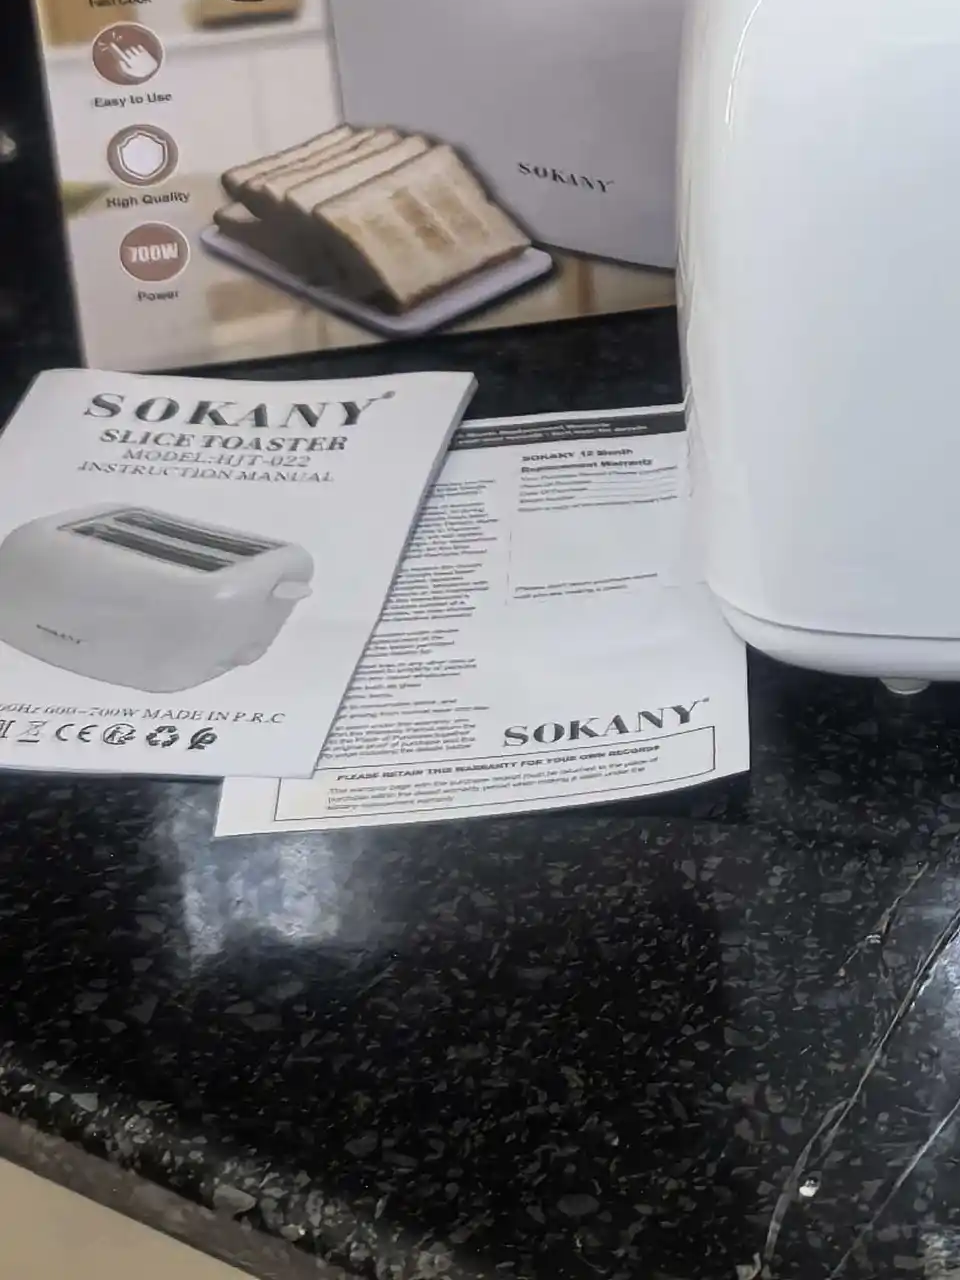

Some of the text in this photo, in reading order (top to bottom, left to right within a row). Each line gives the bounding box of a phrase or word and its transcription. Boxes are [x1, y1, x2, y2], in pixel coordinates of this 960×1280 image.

[93, 90, 173, 109] Easy to Use
[106, 191, 191, 209] High Quality
[125, 242, 179, 263] 700W
[137, 290, 179, 302] Power
[83, 392, 384, 428] SOKANY
[99, 428, 349, 452] SLICE TOASTER
[77, 461, 335, 483] INSTRUCTION MANUAL
[142, 708, 203, 721] MADE
[502, 700, 700, 748] SOKANY
